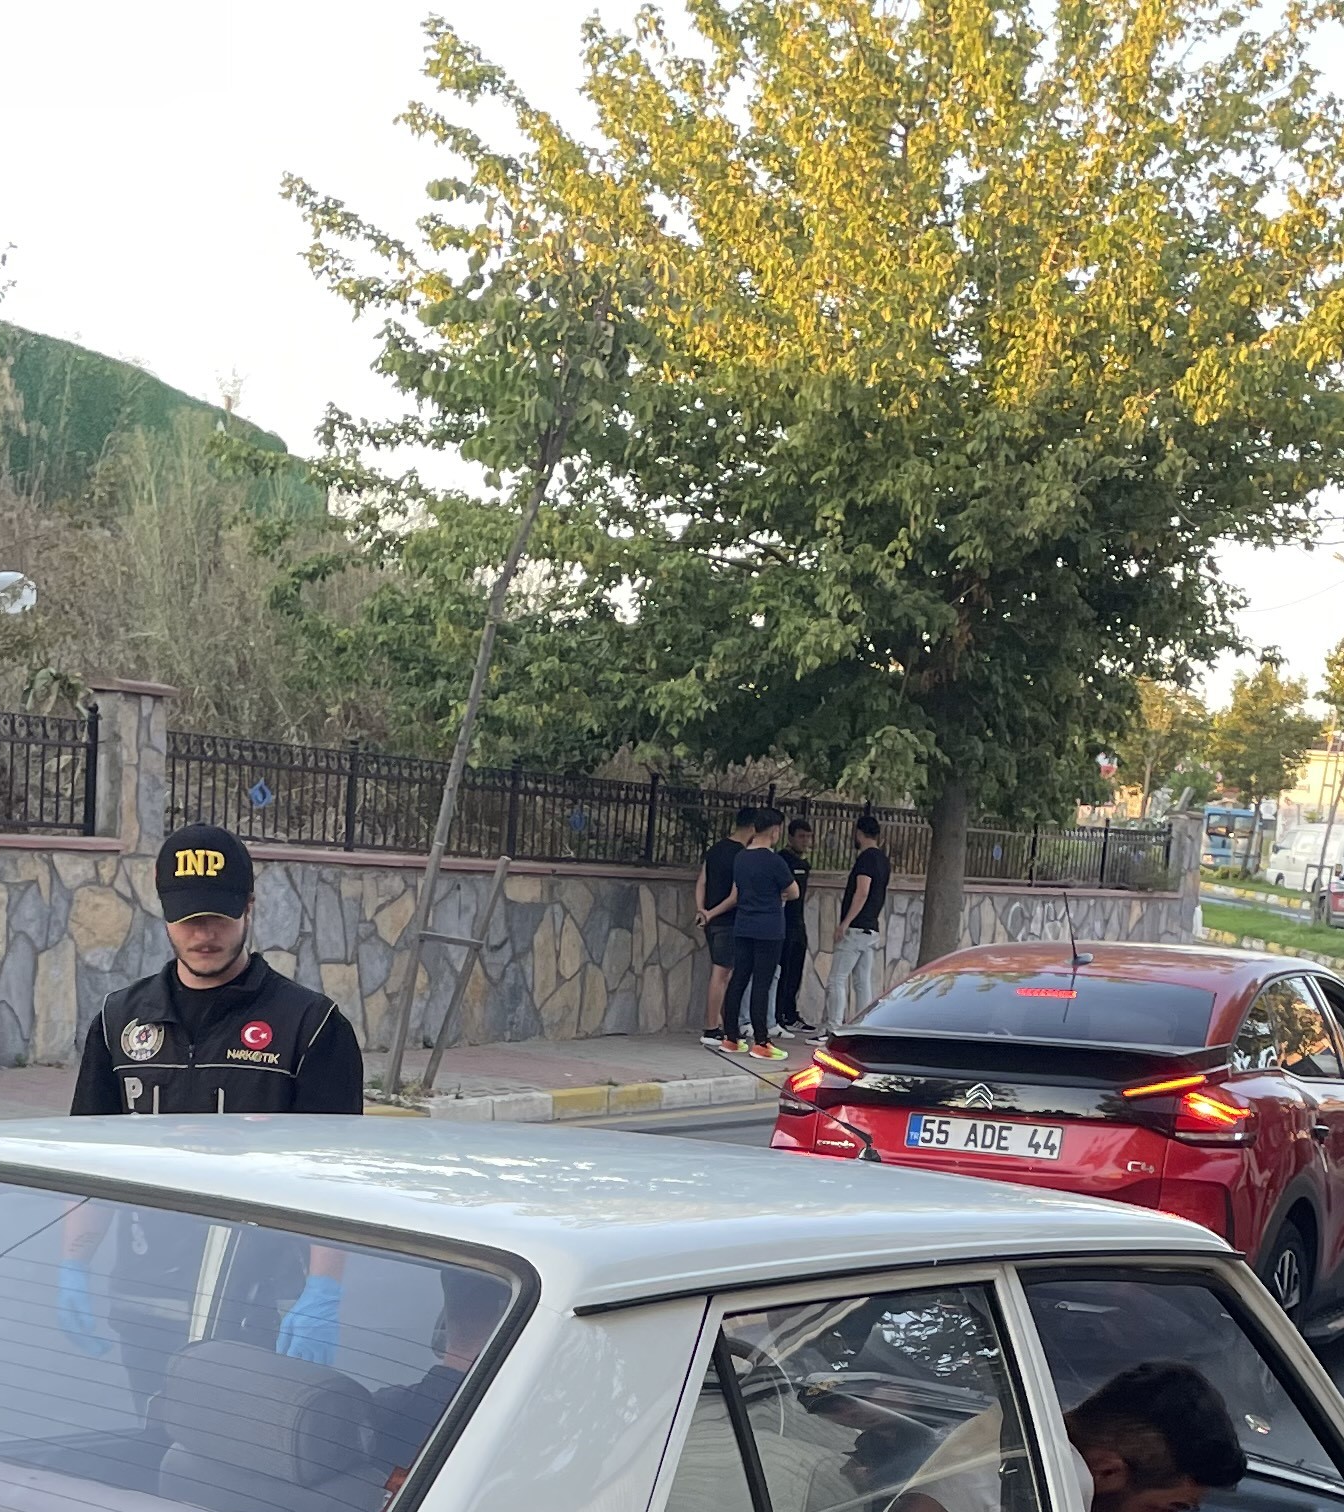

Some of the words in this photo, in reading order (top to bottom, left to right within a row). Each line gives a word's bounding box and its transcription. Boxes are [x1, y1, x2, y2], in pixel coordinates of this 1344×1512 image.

[174, 849, 226, 877] INP
[920, 1119, 951, 1145] 55
[964, 1123, 1013, 1151] ADE
[1027, 1128, 1057, 1156] 44
